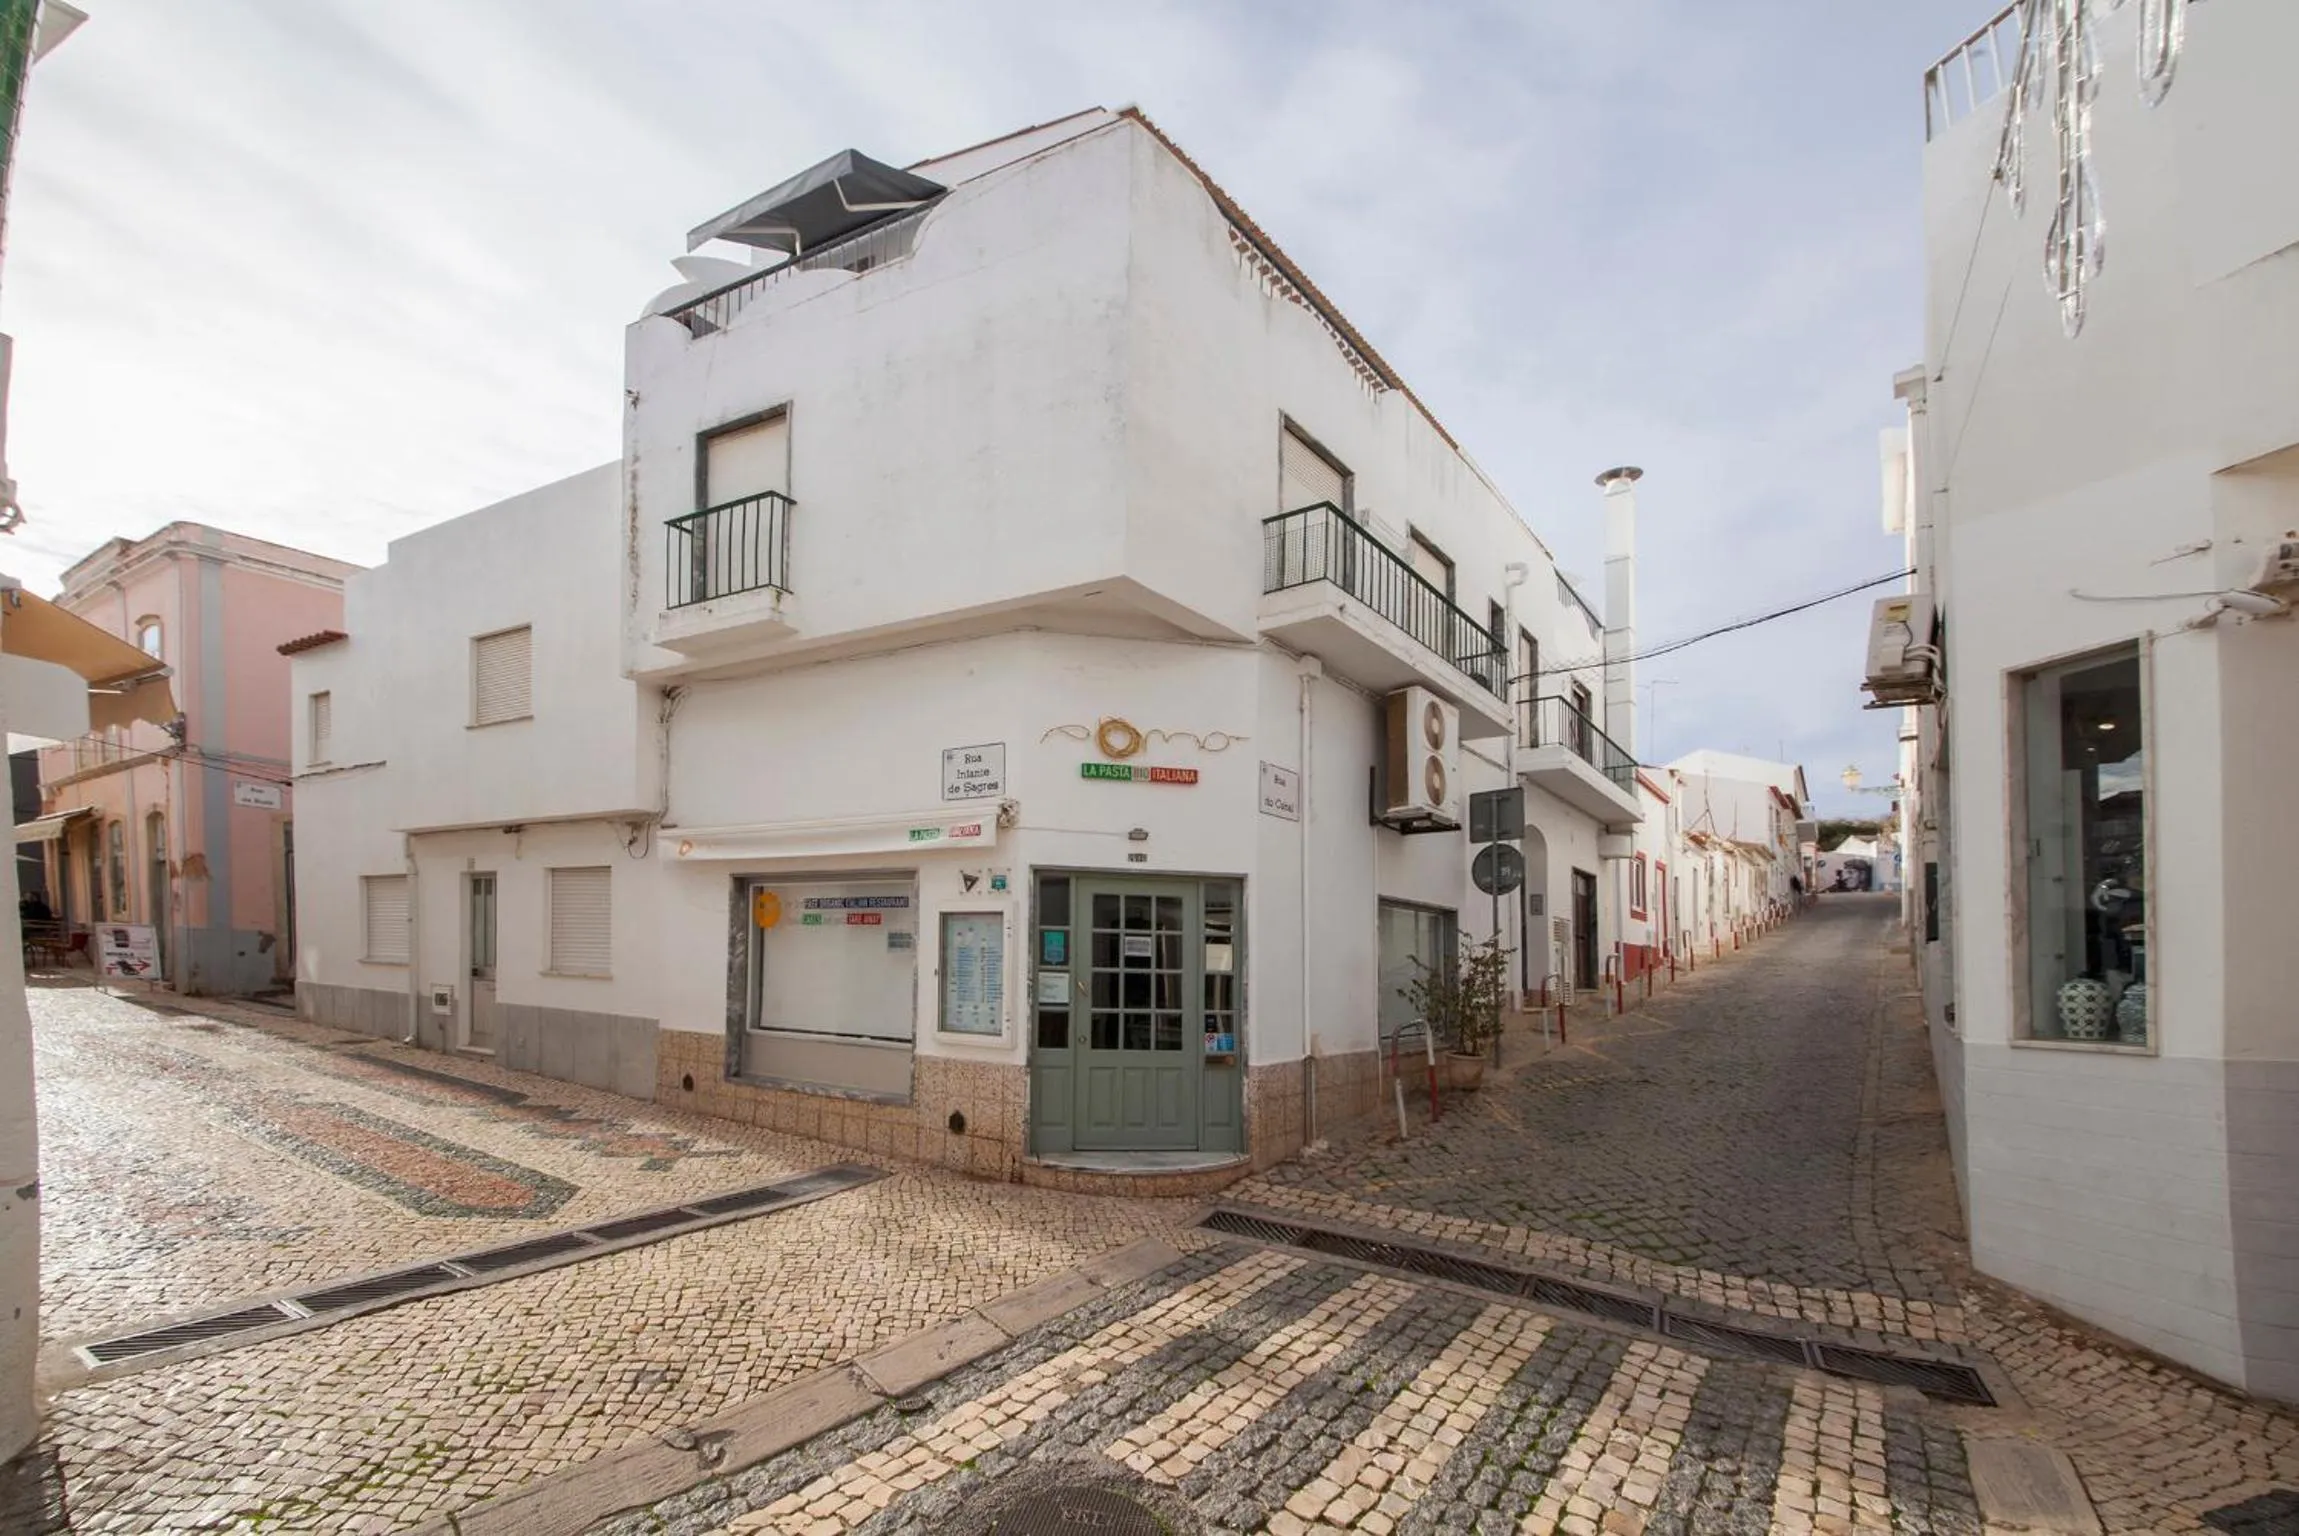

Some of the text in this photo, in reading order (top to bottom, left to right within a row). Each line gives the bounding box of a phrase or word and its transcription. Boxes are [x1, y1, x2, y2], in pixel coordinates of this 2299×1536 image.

[965, 753, 981, 764] Rua
[1083, 764, 1097, 777] LA
[1099, 765, 1130, 778] PASTA
[1151, 768, 1196, 783] ITALIANA
[948, 782, 999, 794] de Sagres
